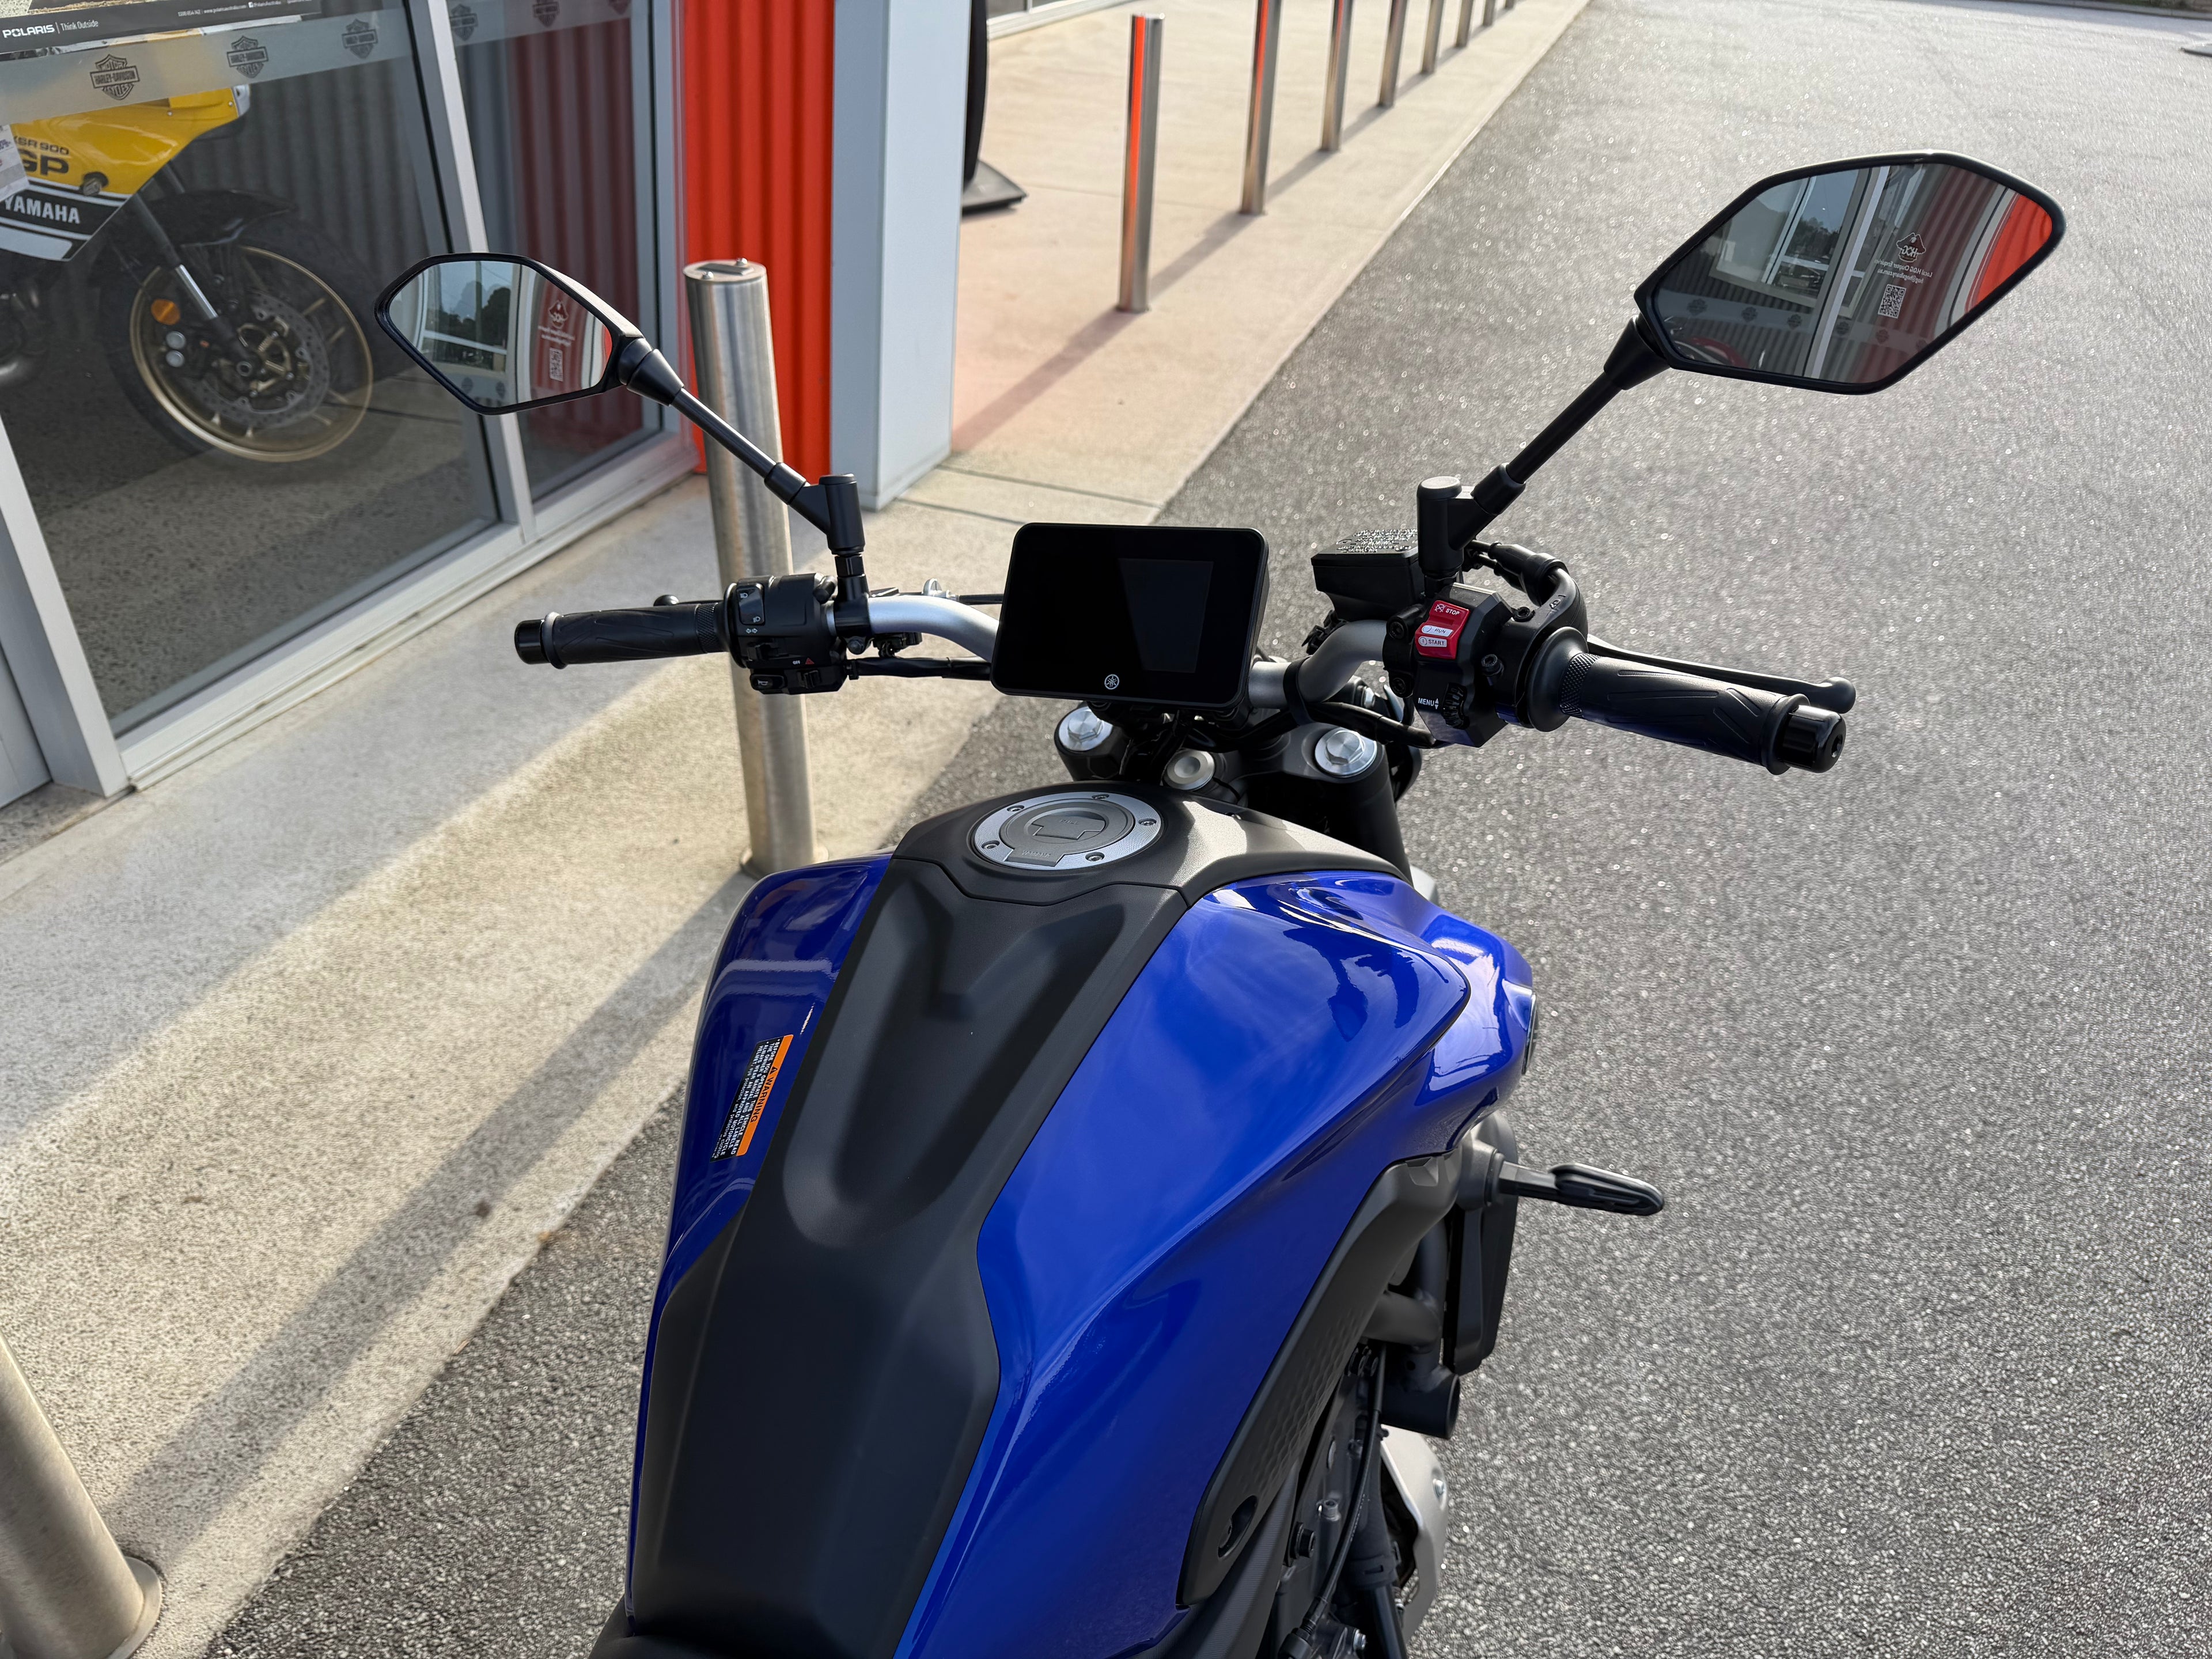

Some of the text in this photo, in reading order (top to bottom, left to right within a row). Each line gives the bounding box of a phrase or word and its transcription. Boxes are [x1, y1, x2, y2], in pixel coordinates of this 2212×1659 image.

[2, 20, 99, 38] POLARIS Think Outside
[40, 142, 69, 155] 900
[4, 195, 80, 224] YAMAHA
[1418, 698, 1434, 706] MENU
[749, 1077, 774, 1122] WARNING
